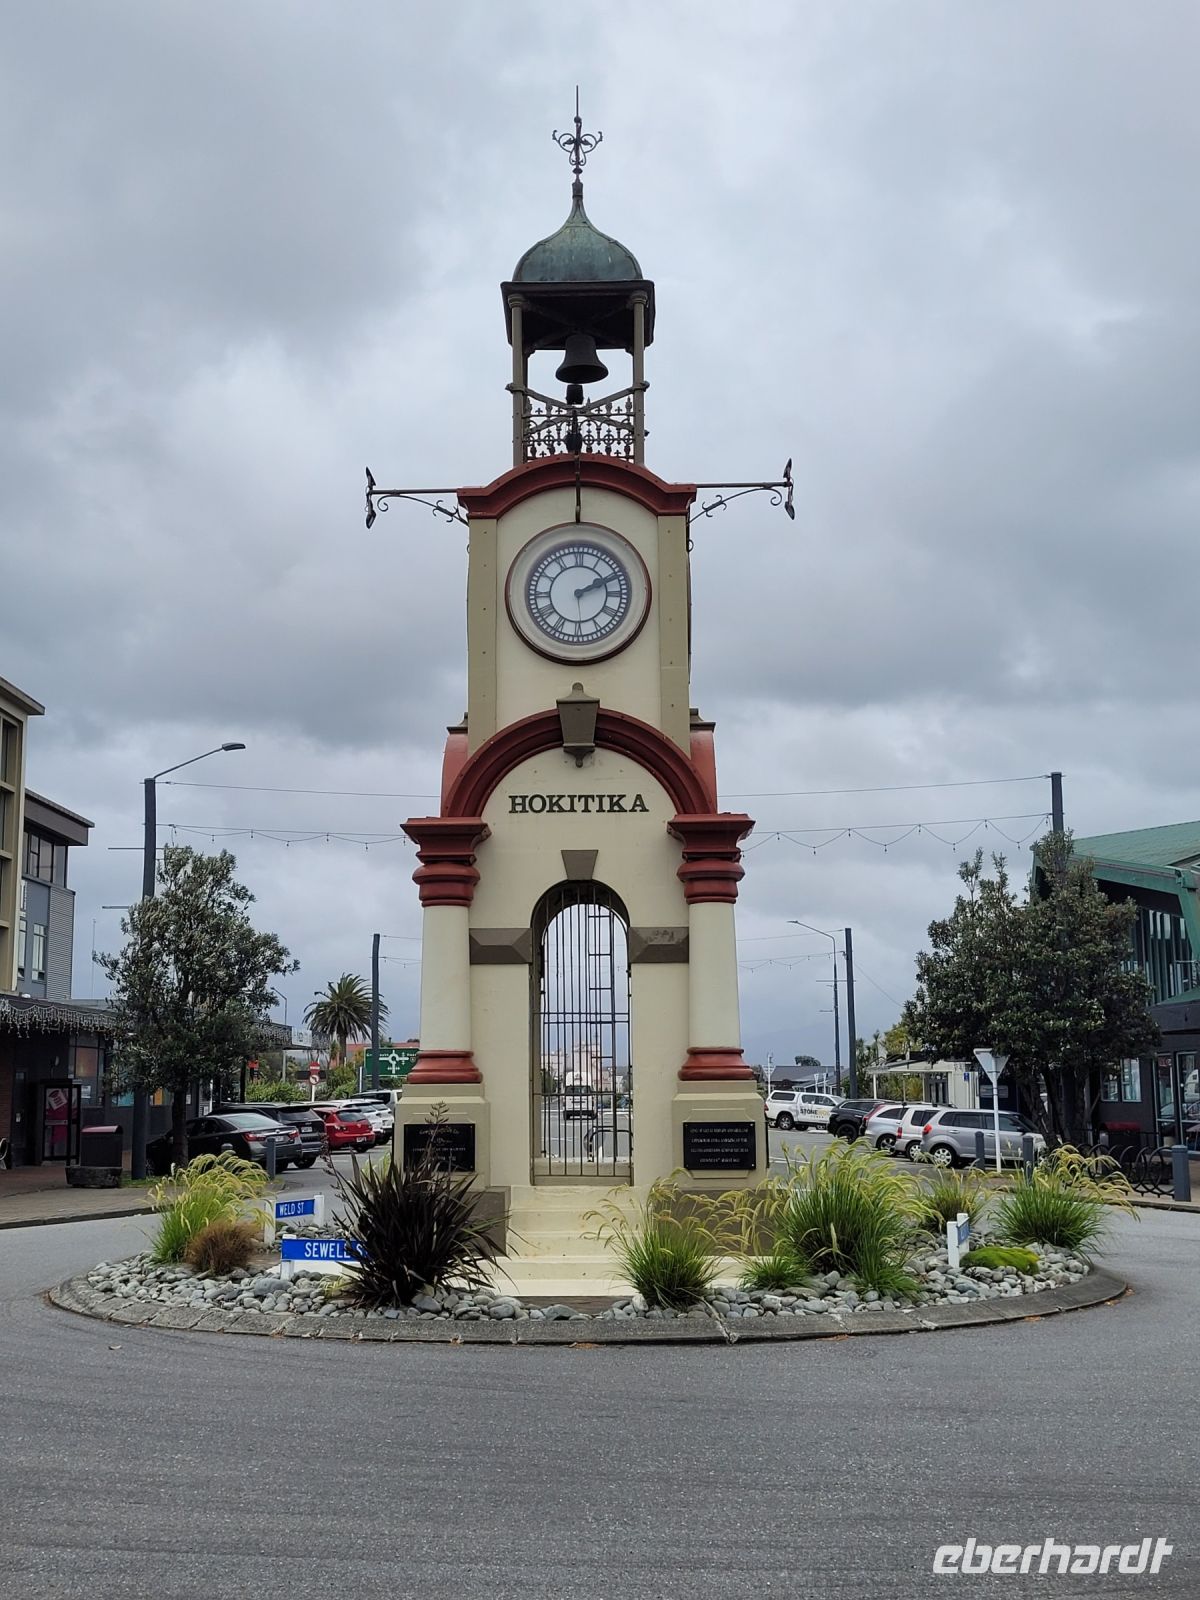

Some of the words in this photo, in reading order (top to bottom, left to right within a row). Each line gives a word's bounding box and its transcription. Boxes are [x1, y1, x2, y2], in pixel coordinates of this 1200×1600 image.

[508, 794, 650, 813] HOKITIKA
[279, 1203, 296, 1216] WELD
[297, 1202, 305, 1214] ST
[304, 1242, 351, 1258] SEWELL
